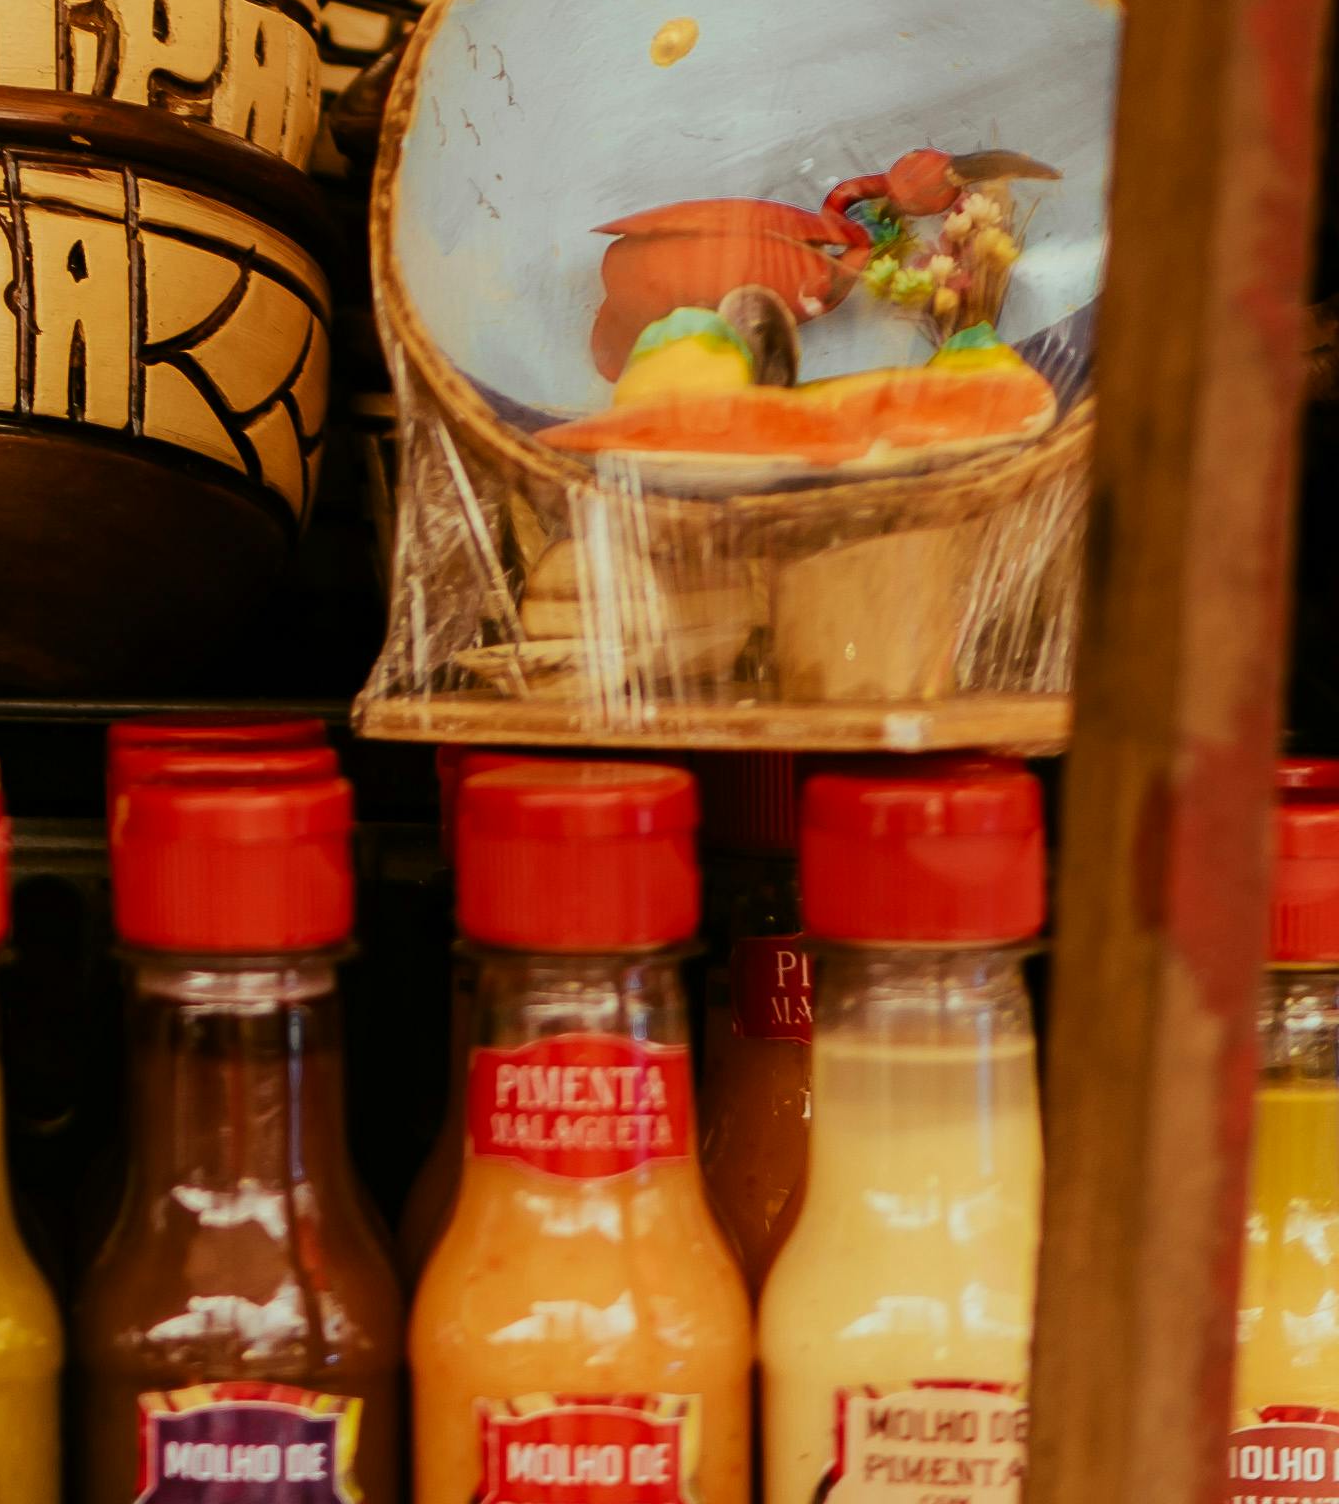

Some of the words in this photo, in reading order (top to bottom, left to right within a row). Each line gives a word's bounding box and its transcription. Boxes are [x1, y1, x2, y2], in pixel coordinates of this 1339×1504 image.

[496, 1064, 668, 1110] PIMENTA
[490, 1112, 674, 1150] MALAGUETA
[867, 1407, 978, 1444] MOLHO
[164, 1440, 281, 1483] MOLHO
[284, 1442, 328, 1483] DE
[506, 1441, 623, 1485] MOLHO
[630, 1442, 673, 1485] DE
[863, 1453, 1028, 1487] PIMENTA
